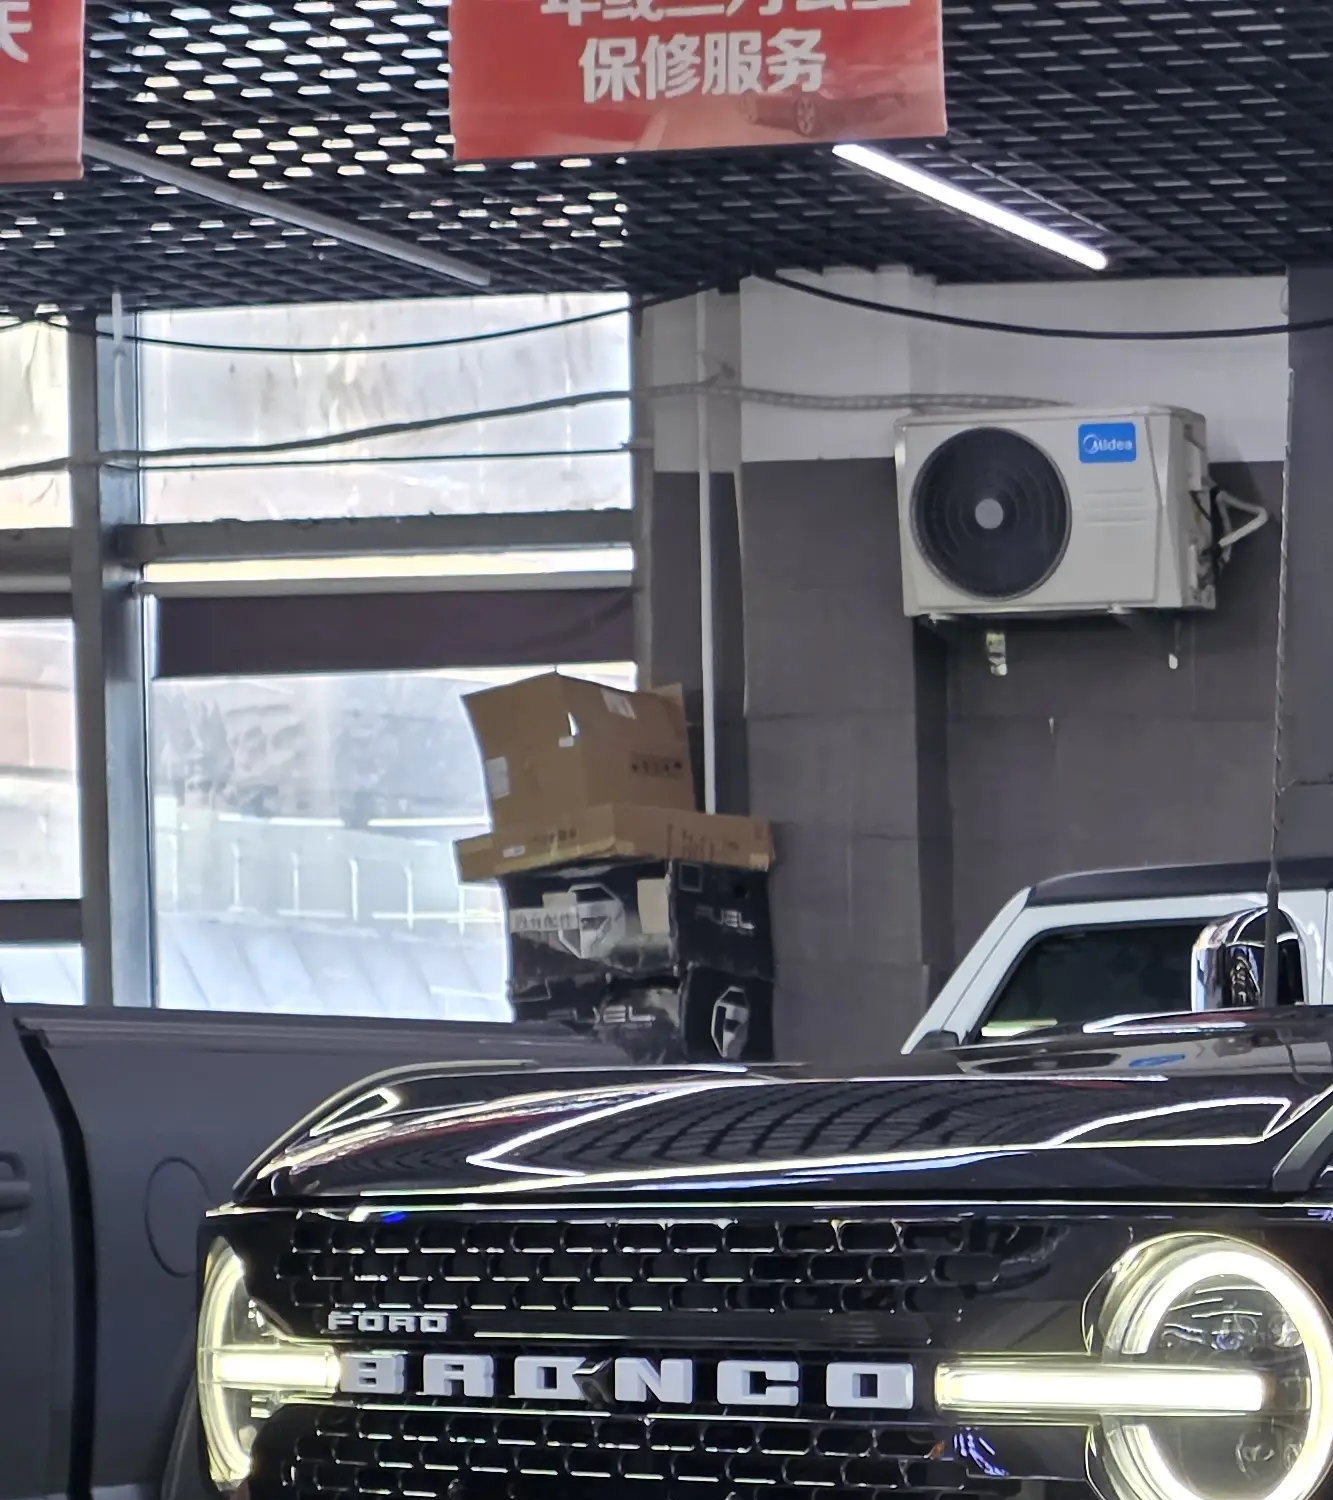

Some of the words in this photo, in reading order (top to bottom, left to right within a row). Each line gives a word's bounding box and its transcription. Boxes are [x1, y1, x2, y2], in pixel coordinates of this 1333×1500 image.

[578, 28, 826, 103] 保修服务
[327, 1311, 449, 1333] FORD
[339, 1352, 914, 1409] BRONCO
